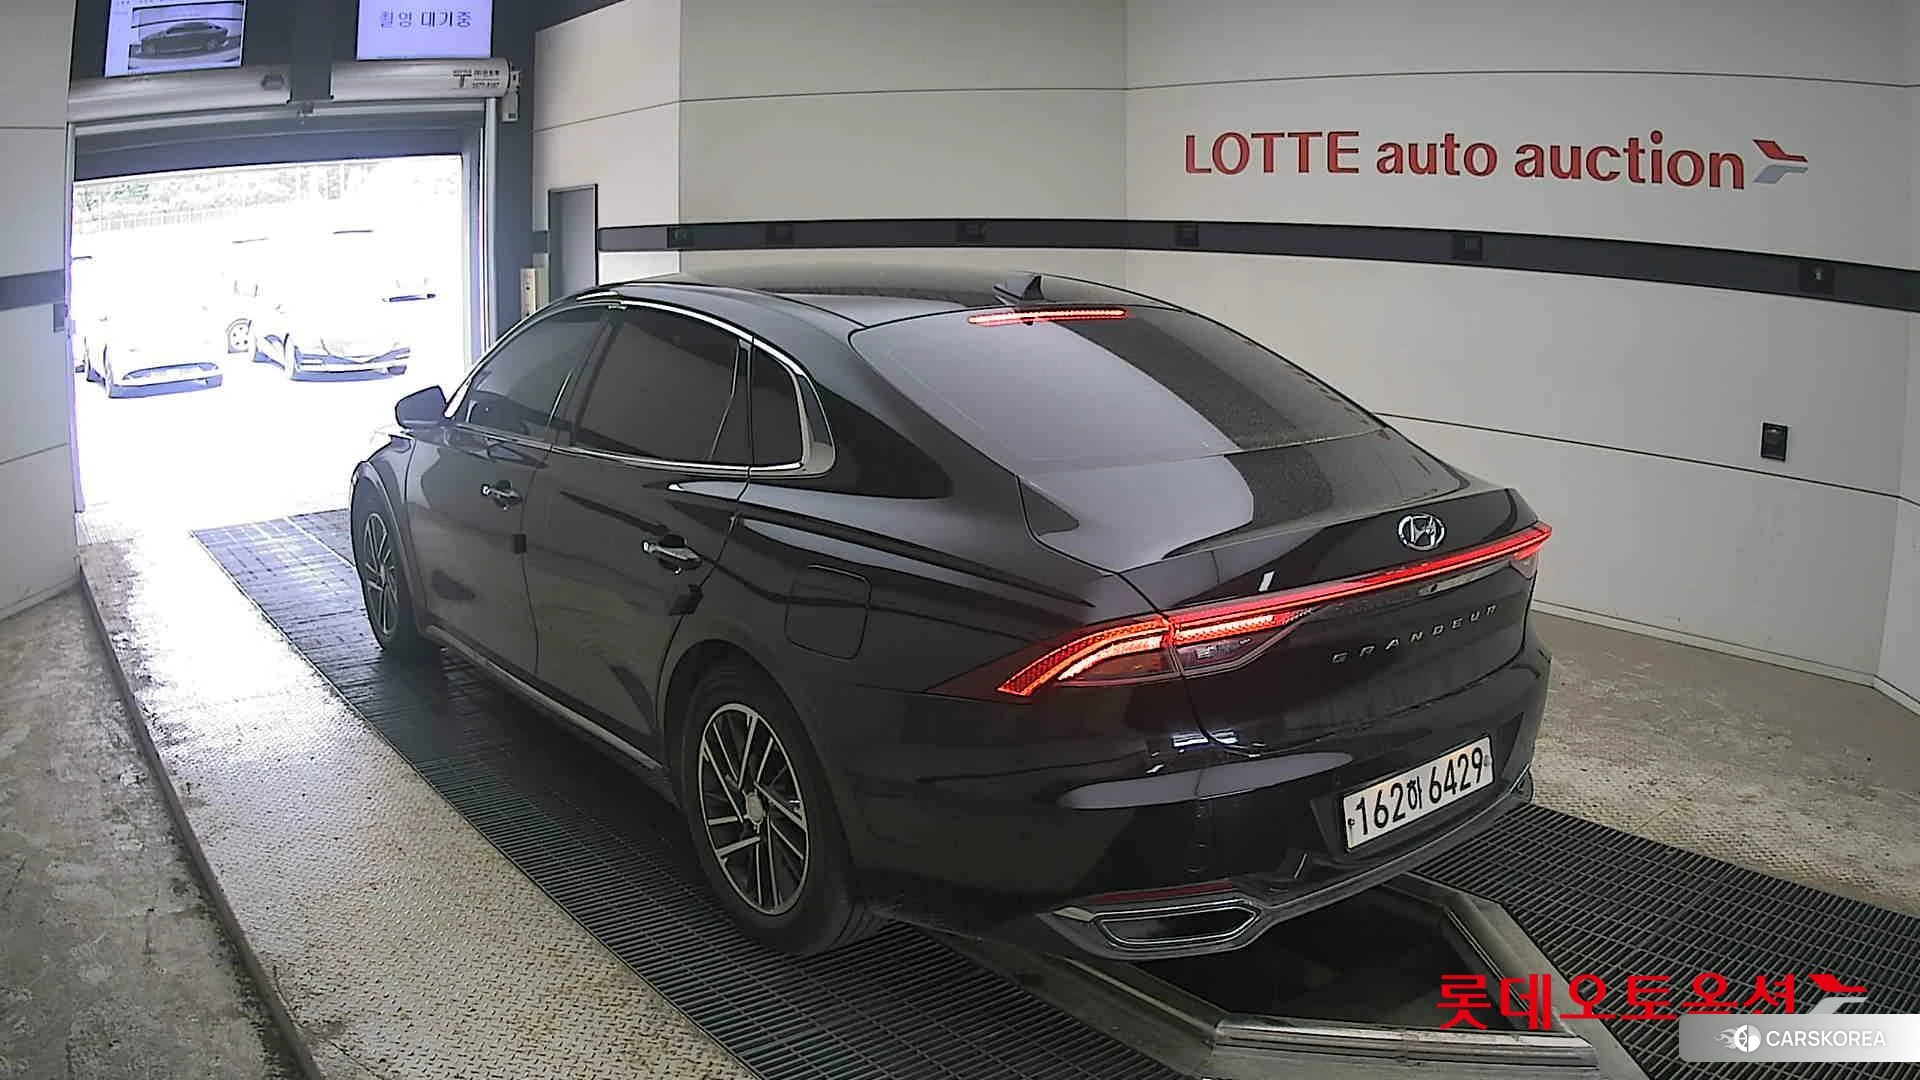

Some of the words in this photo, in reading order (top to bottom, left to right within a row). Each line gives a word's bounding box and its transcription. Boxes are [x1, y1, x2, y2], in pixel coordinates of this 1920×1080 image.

[421, 11, 472, 28] 대기중
[1184, 130, 1361, 175] LOTTE
[1376, 132, 1499, 177] auto
[1514, 130, 1745, 190] auction
[1332, 604, 1497, 664] GRANDEUR
[1355, 775, 1423, 836] 162하
[1428, 747, 1484, 804] 6429
